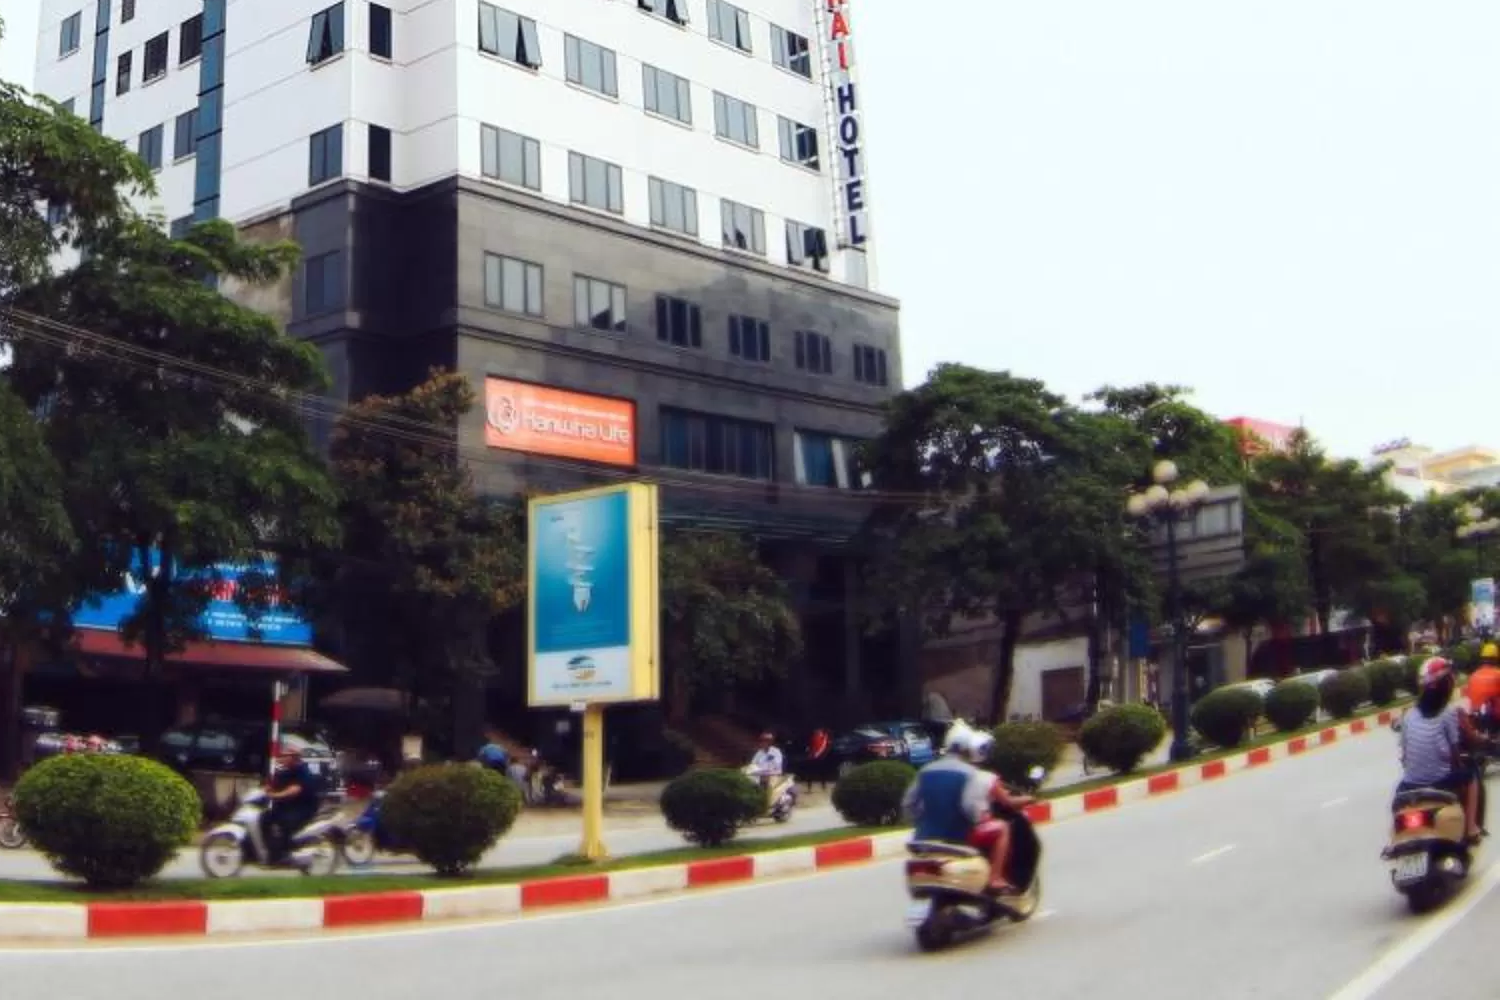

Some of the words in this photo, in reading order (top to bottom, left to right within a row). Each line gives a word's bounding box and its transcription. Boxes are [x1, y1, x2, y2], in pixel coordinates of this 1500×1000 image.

[837, 83, 866, 244] HOTEL
[524, 411, 596, 440] Hanwha
[599, 420, 630, 443] Life
